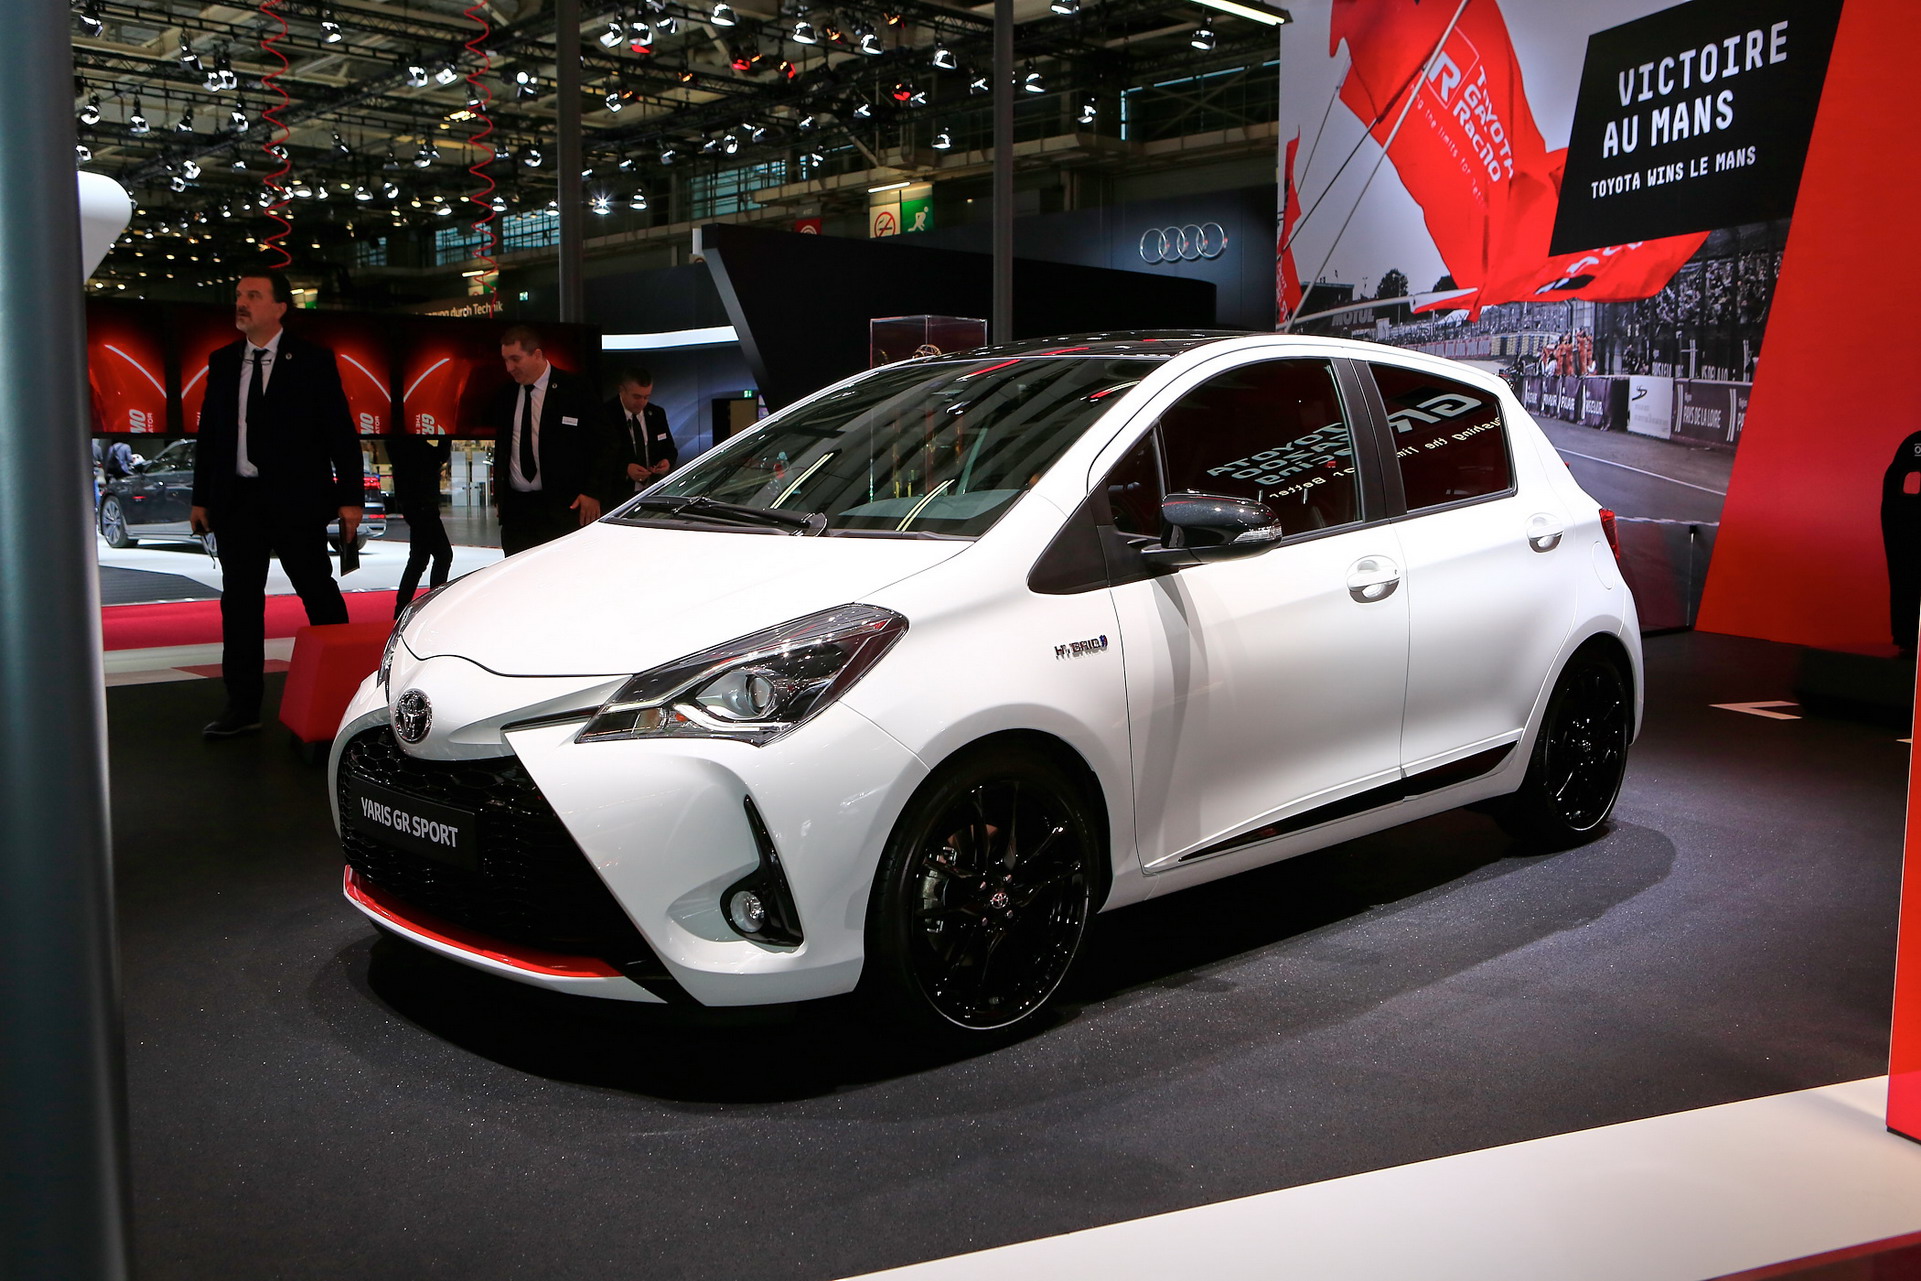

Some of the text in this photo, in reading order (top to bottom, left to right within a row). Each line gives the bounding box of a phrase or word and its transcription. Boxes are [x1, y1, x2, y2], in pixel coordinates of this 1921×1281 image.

[1618, 20, 1788, 107] VICTOIRE
[1603, 89, 1734, 159] AU MANS
[1591, 145, 1756, 199] TOYOTA WINS LE MANS
[1332, 308, 1375, 327] MOTUL
[361, 796, 458, 848] YARIS GR SPORT
